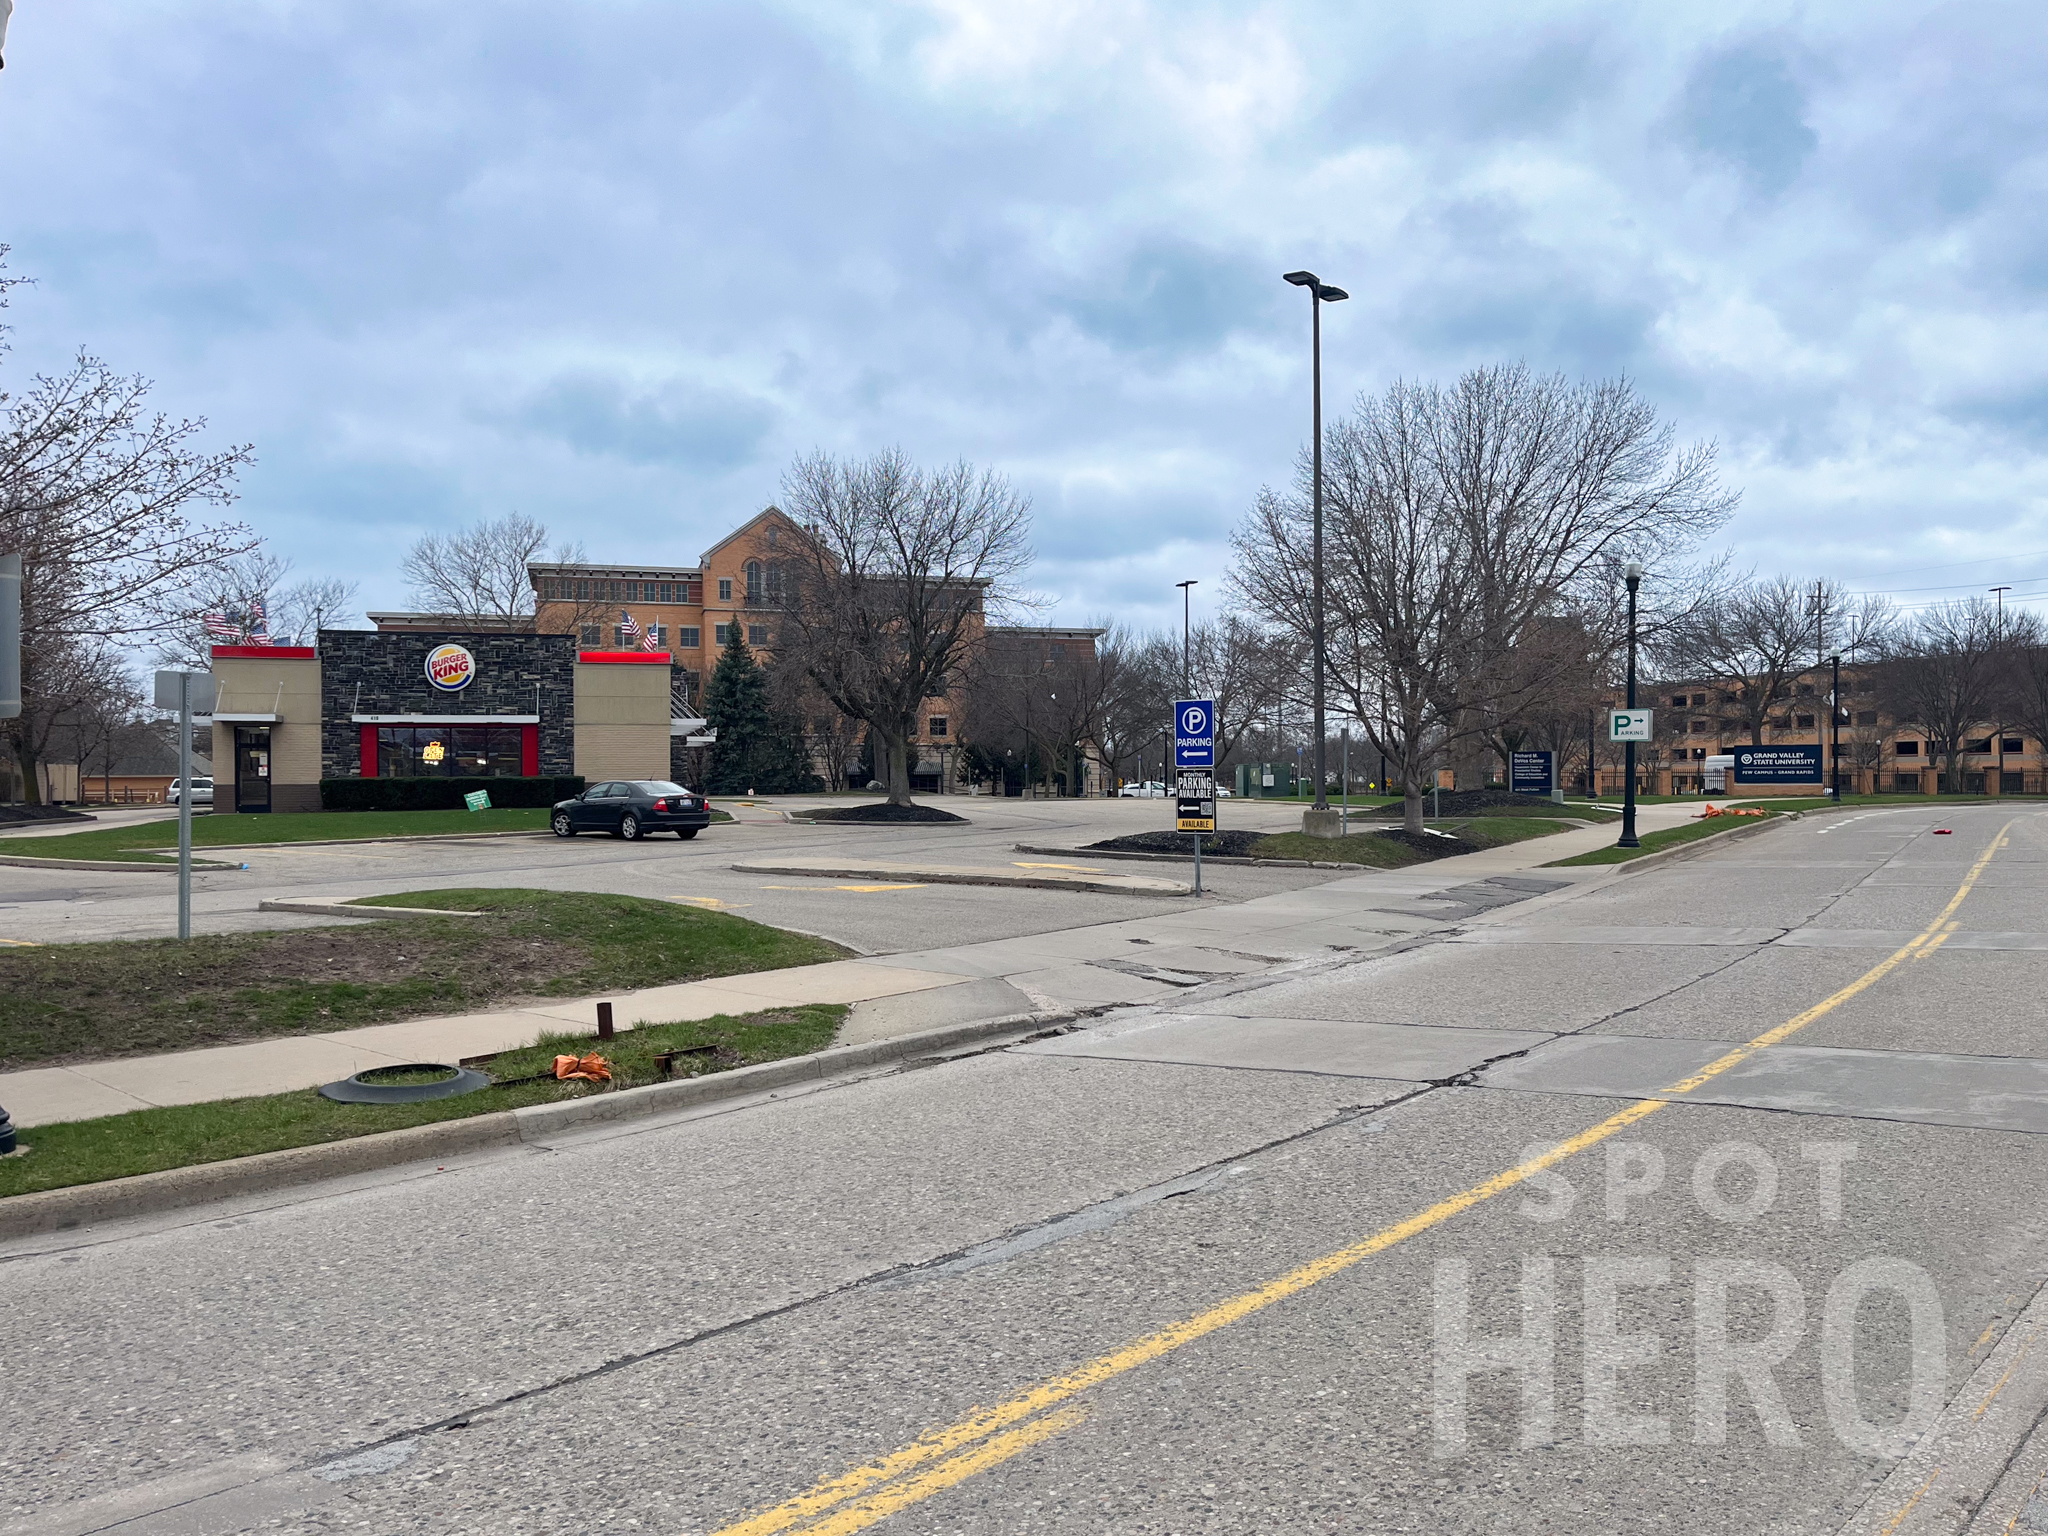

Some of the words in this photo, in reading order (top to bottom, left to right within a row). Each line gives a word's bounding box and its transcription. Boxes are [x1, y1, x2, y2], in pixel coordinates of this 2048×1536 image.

[431, 653, 467, 669] BURGER
[433, 661, 469, 681] KING
[1188, 711, 1202, 730] P
[1177, 737, 1212, 747] PARKING
[1178, 777, 1212, 789] PARKING
[1178, 789, 1212, 799] AVAILABLE
[1181, 820, 1210, 828] AVAILABLE
